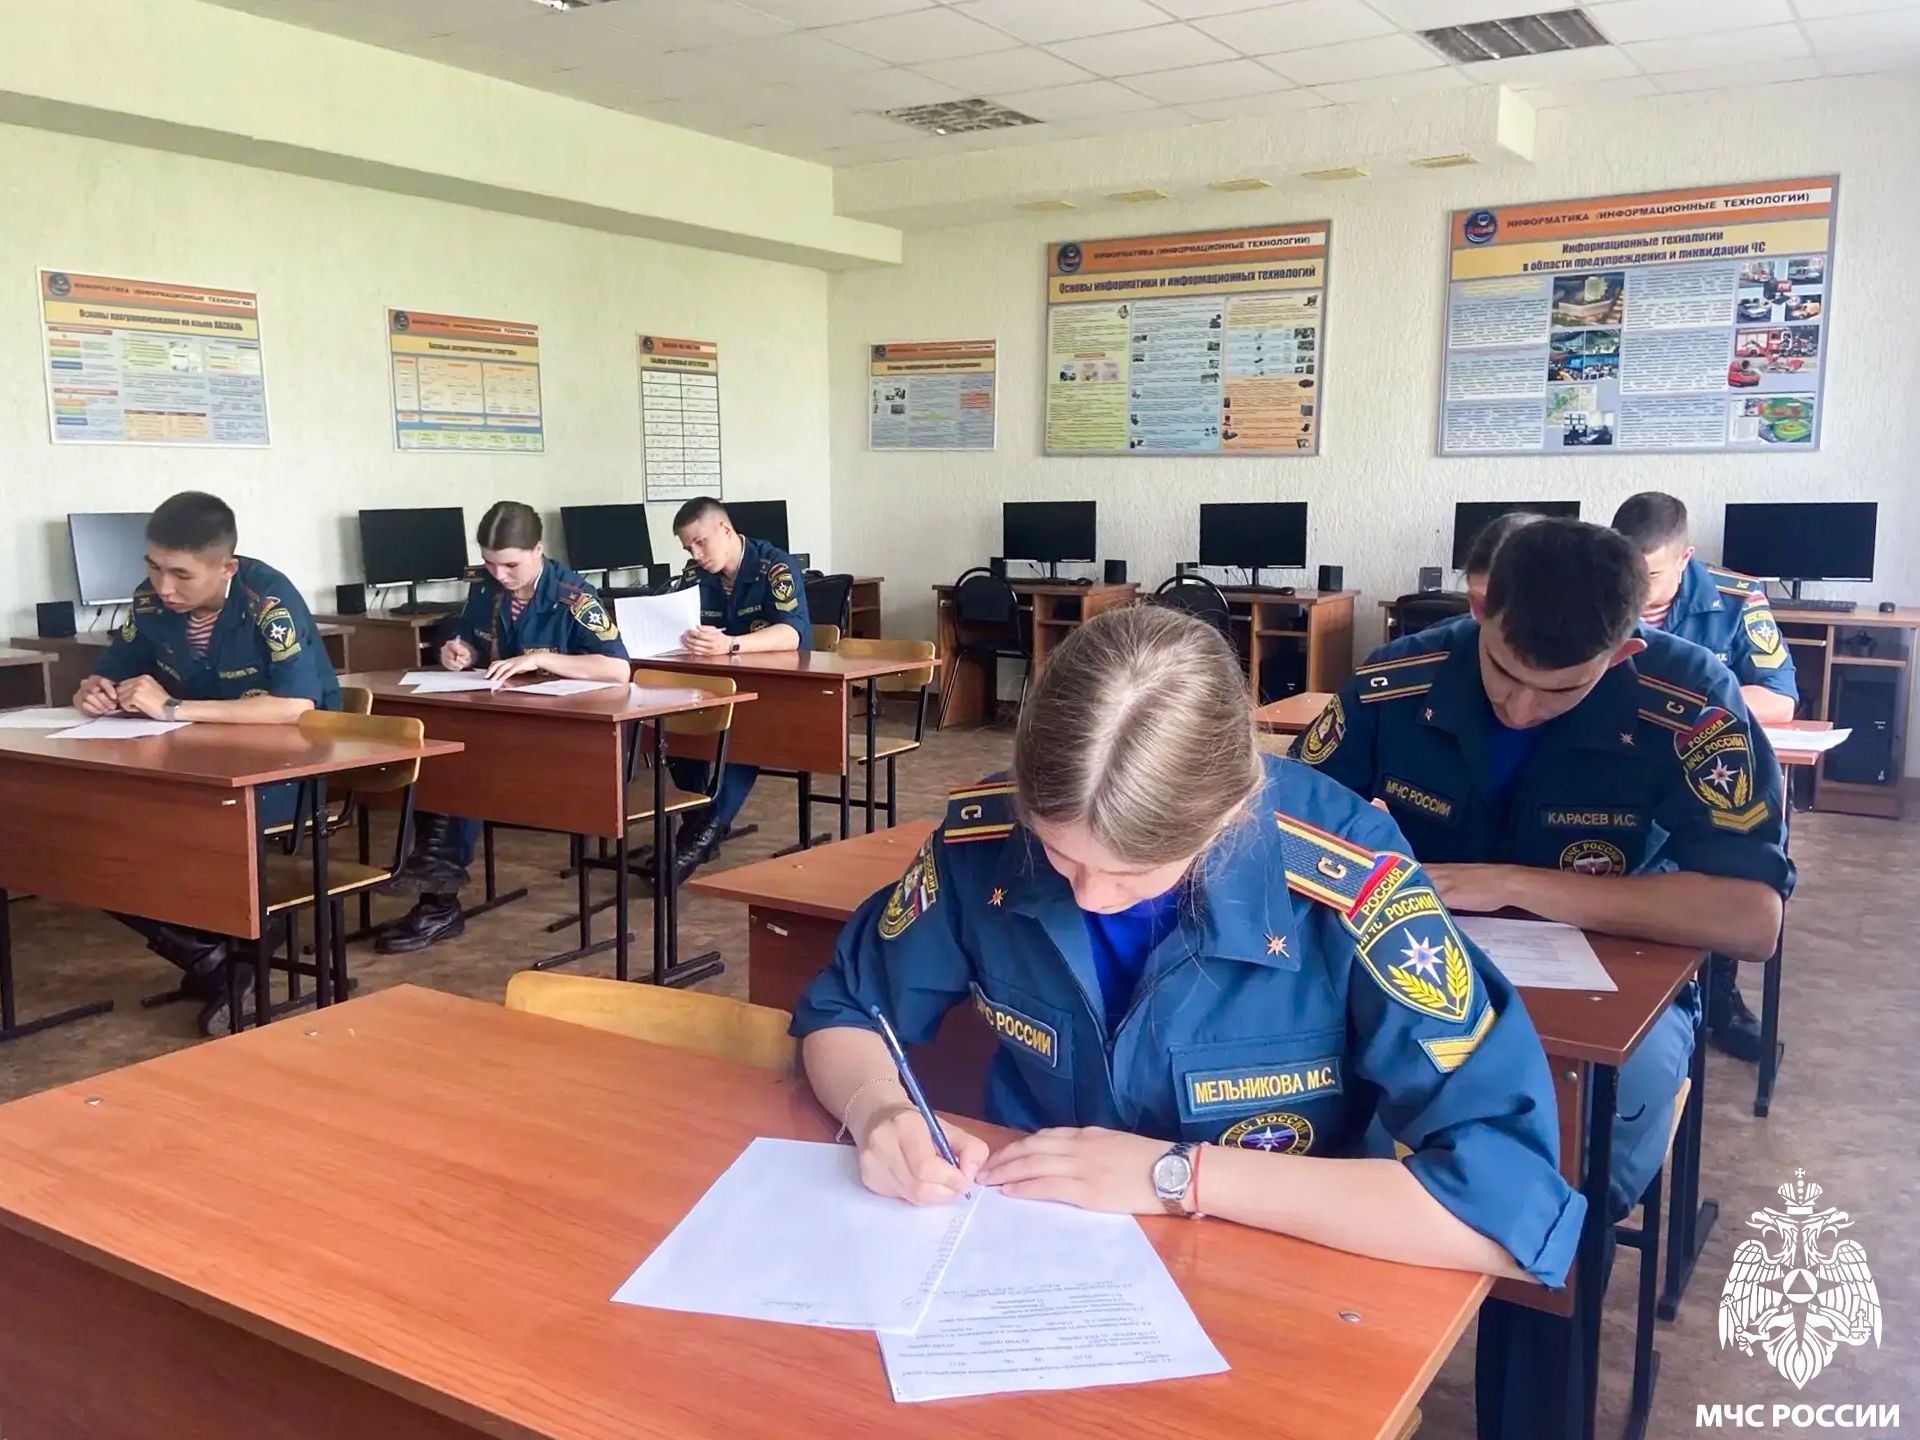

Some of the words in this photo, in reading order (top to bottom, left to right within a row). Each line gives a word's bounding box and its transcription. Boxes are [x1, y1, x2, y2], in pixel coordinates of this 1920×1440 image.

[1507, 212, 1589, 228] ИНФОРМАТИКА
[1596, 200, 1716, 220] (ИНФОРМАЦИОННЫЕ
[1723, 192, 1810, 208] ТЕХНОЛОГИИ)
[1247, 236, 1311, 249] ТЕХНОЛОГИИ)
[1530, 258, 1572, 272] области
[1573, 251, 1668, 270] предупреждения
[1668, 250, 1677, 260] и
[1678, 242, 1750, 261] ликвидации
[1750, 241, 1767, 255] ЧС
[1562, 235, 1659, 254] Информационные
[1660, 230, 1723, 246] технологии
[1059, 281, 1093, 294] Основы
[1094, 276, 1158, 292] информатики
[1159, 277, 1166, 288] и
[1167, 270, 1256, 287] информационных
[1257, 264, 1316, 281] технологий
[1687, 719, 1726, 749] РОССИЯ
[1685, 750, 1705, 770] МЧС
[1704, 735, 1745, 754] РОССИИ
[1386, 780, 1409, 799] МЧС
[1408, 790, 1452, 817] РОССИИ
[1548, 812, 1609, 826] КАРАСЕВ
[1360, 867, 1404, 917] РОССИЯ
[1384, 895, 1438, 921] РОССИИ
[995, 1011, 1052, 1057] РОССИИ
[1194, 1073, 1305, 1105] МЕЛЬНИКОВА
[1307, 1066, 1337, 1090] М.С.
